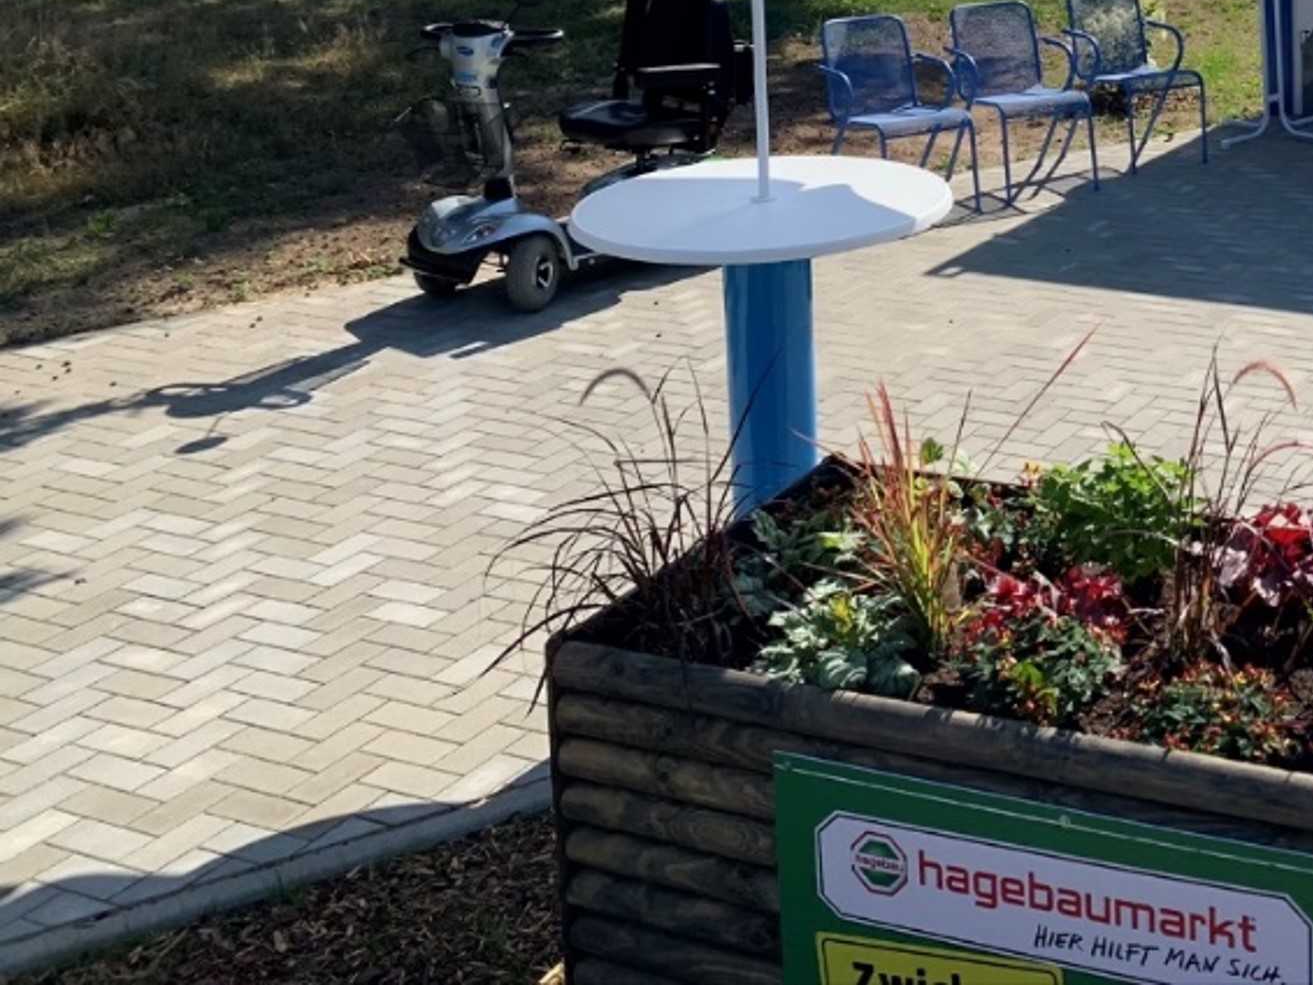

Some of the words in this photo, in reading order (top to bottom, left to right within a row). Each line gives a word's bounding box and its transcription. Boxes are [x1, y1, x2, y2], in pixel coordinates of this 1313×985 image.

[918, 849, 1257, 953] hagebaumarkt
[1034, 923, 1084, 951] HIER
[1091, 937, 1159, 965] HILFT
[1164, 947, 1222, 973] MAN
